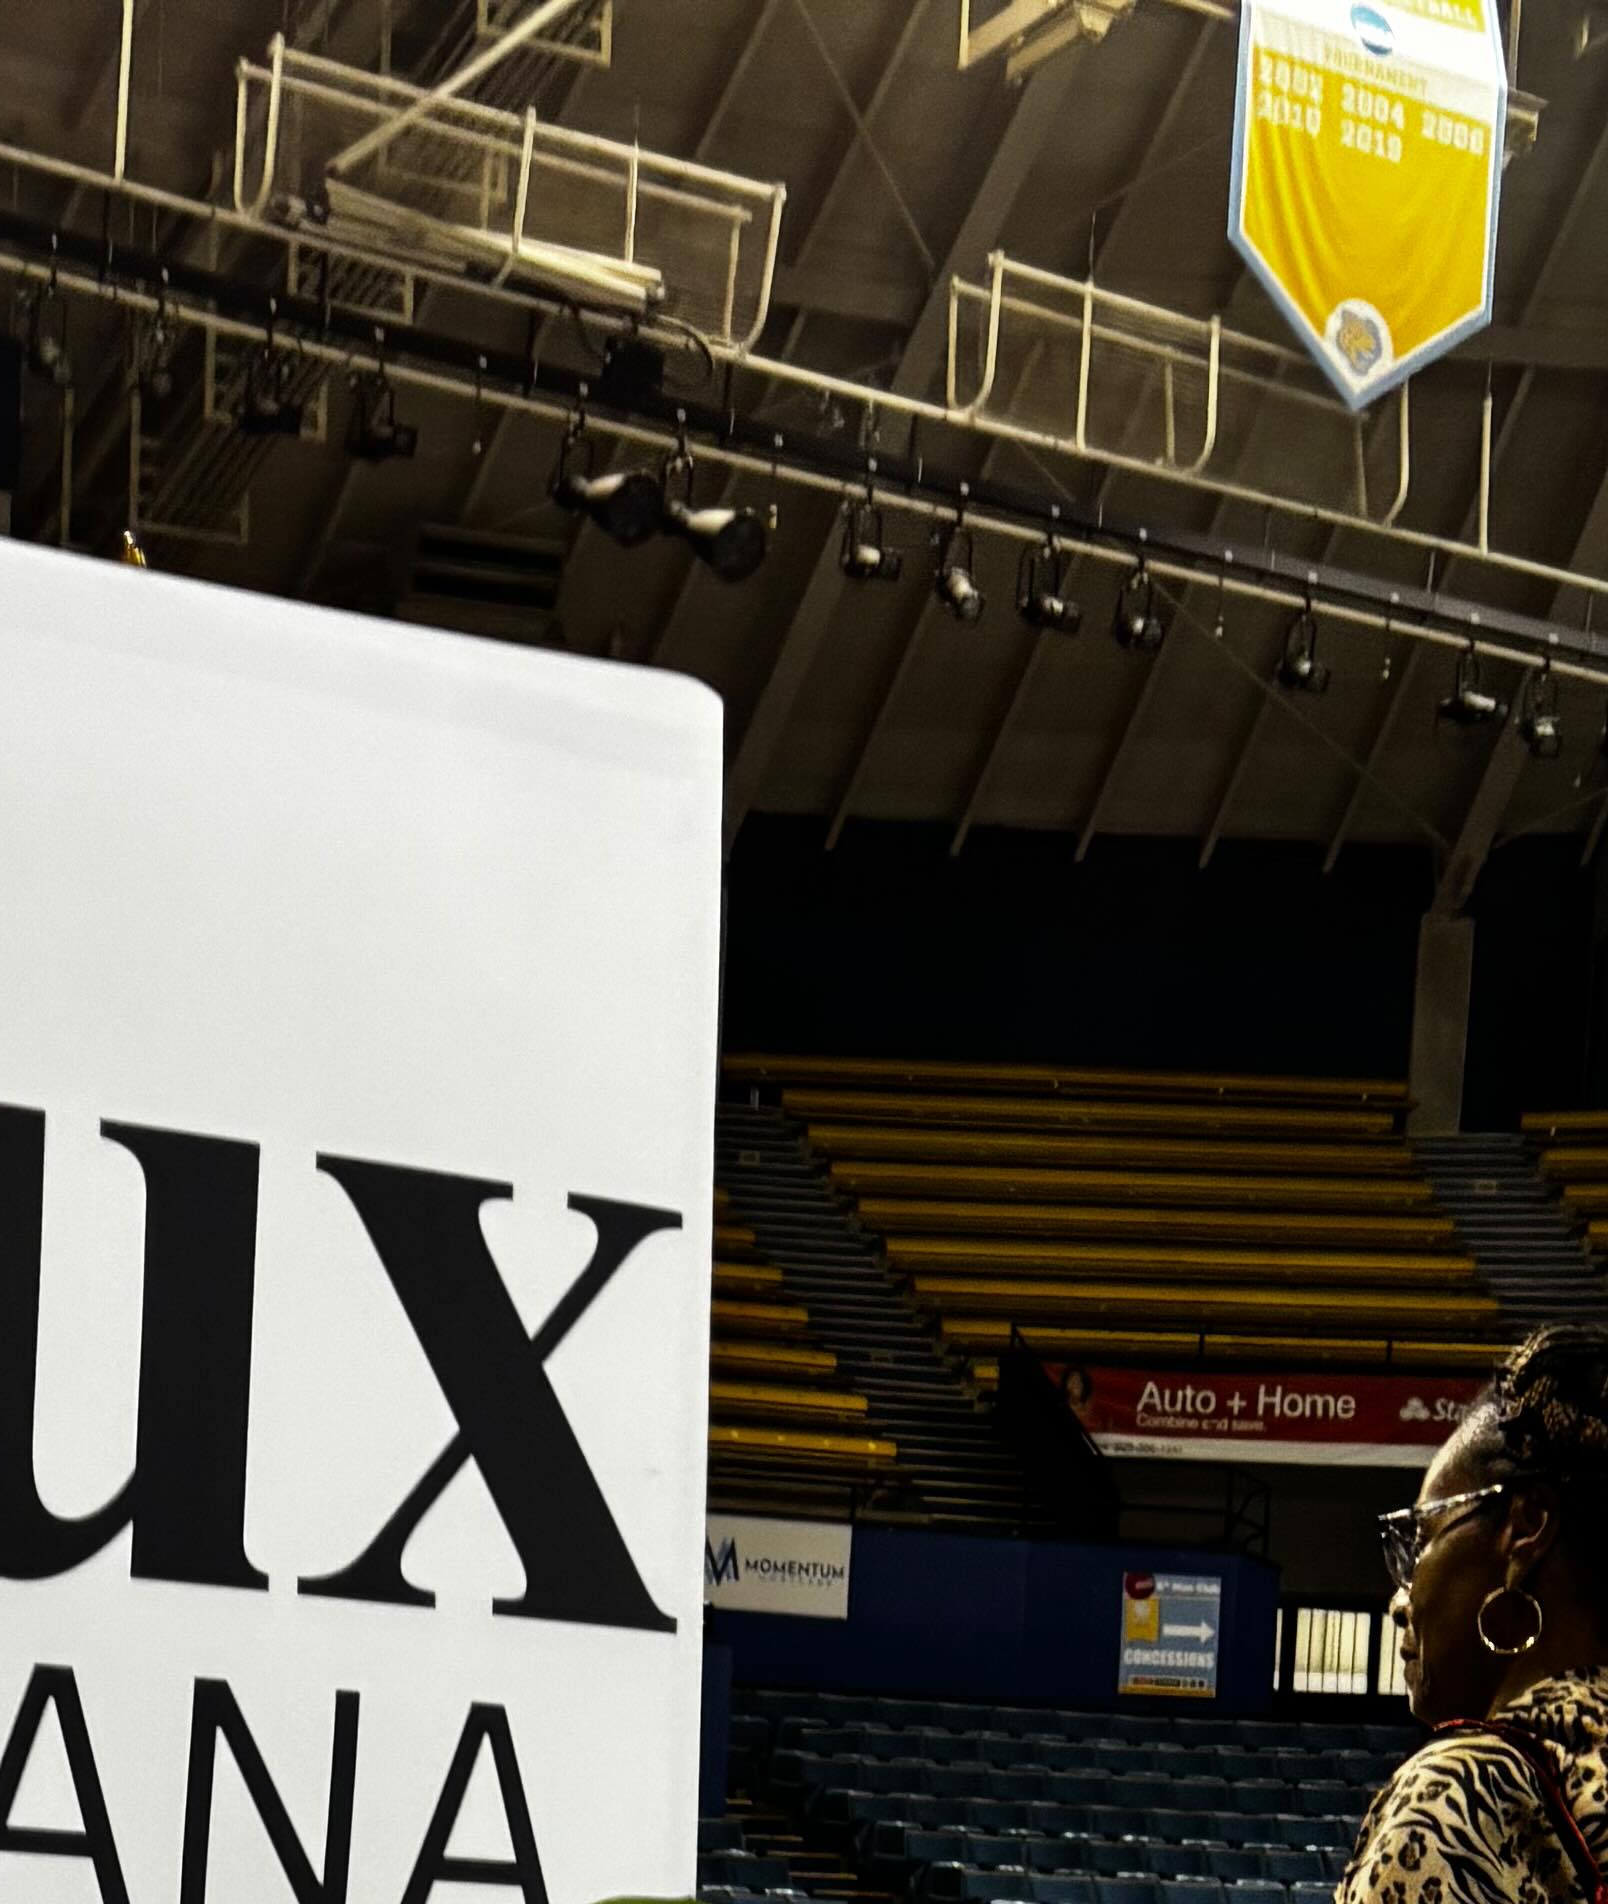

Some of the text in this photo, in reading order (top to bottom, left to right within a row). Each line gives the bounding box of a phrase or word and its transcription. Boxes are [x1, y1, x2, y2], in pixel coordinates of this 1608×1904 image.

[1137, 1382, 1355, 1419] Auto + Home
[745, 1558, 844, 1579] MOMENTUM
